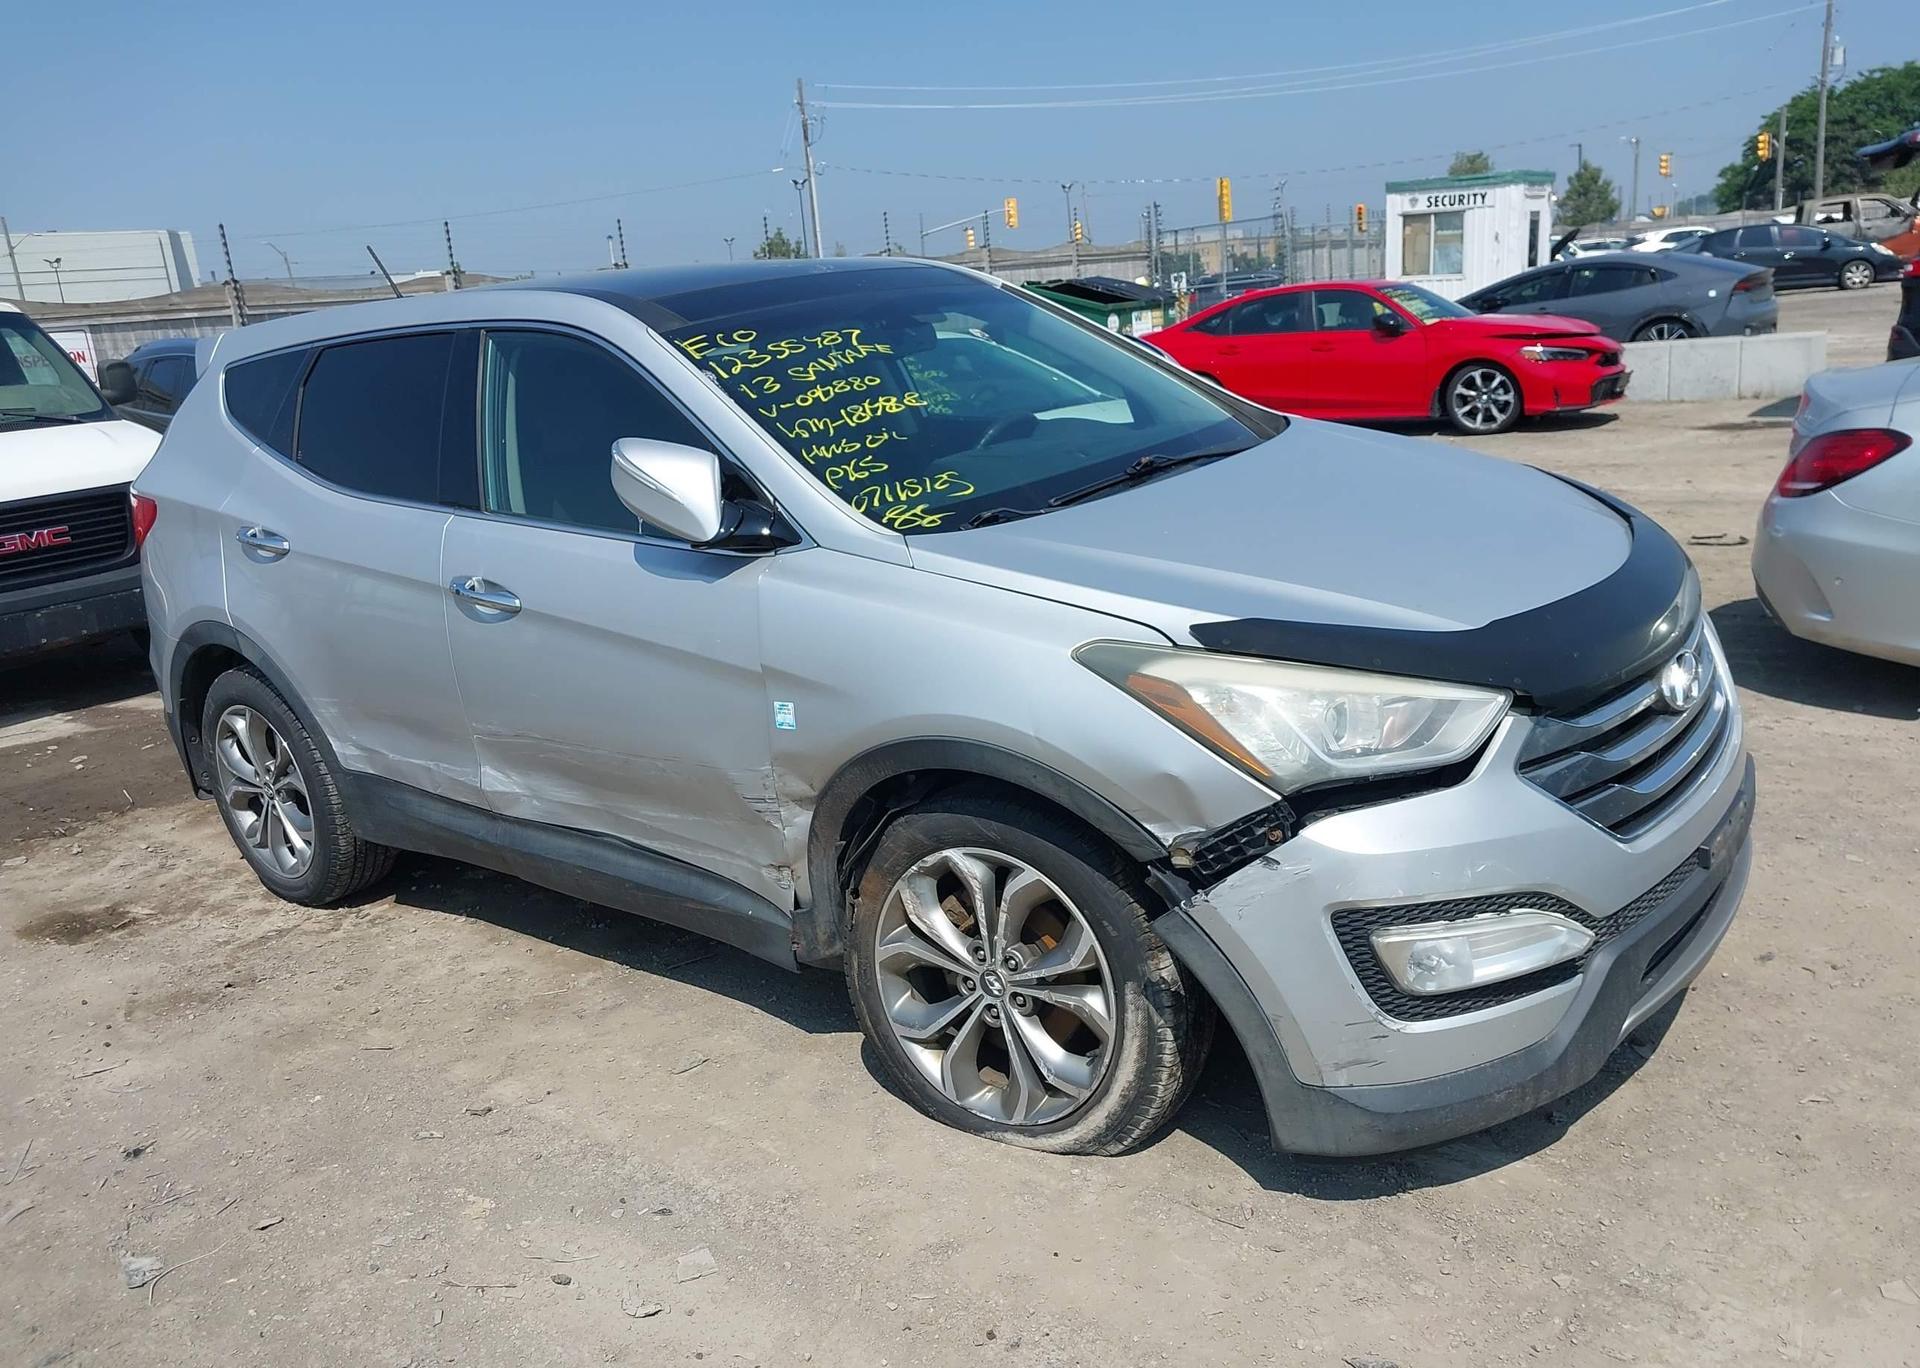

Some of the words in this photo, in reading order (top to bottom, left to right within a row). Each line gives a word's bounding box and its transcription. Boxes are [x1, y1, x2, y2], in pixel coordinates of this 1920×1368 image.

[1426, 192, 1488, 208] SECURITY
[738, 376, 781, 399] 13
[0, 525, 72, 554] GMC
